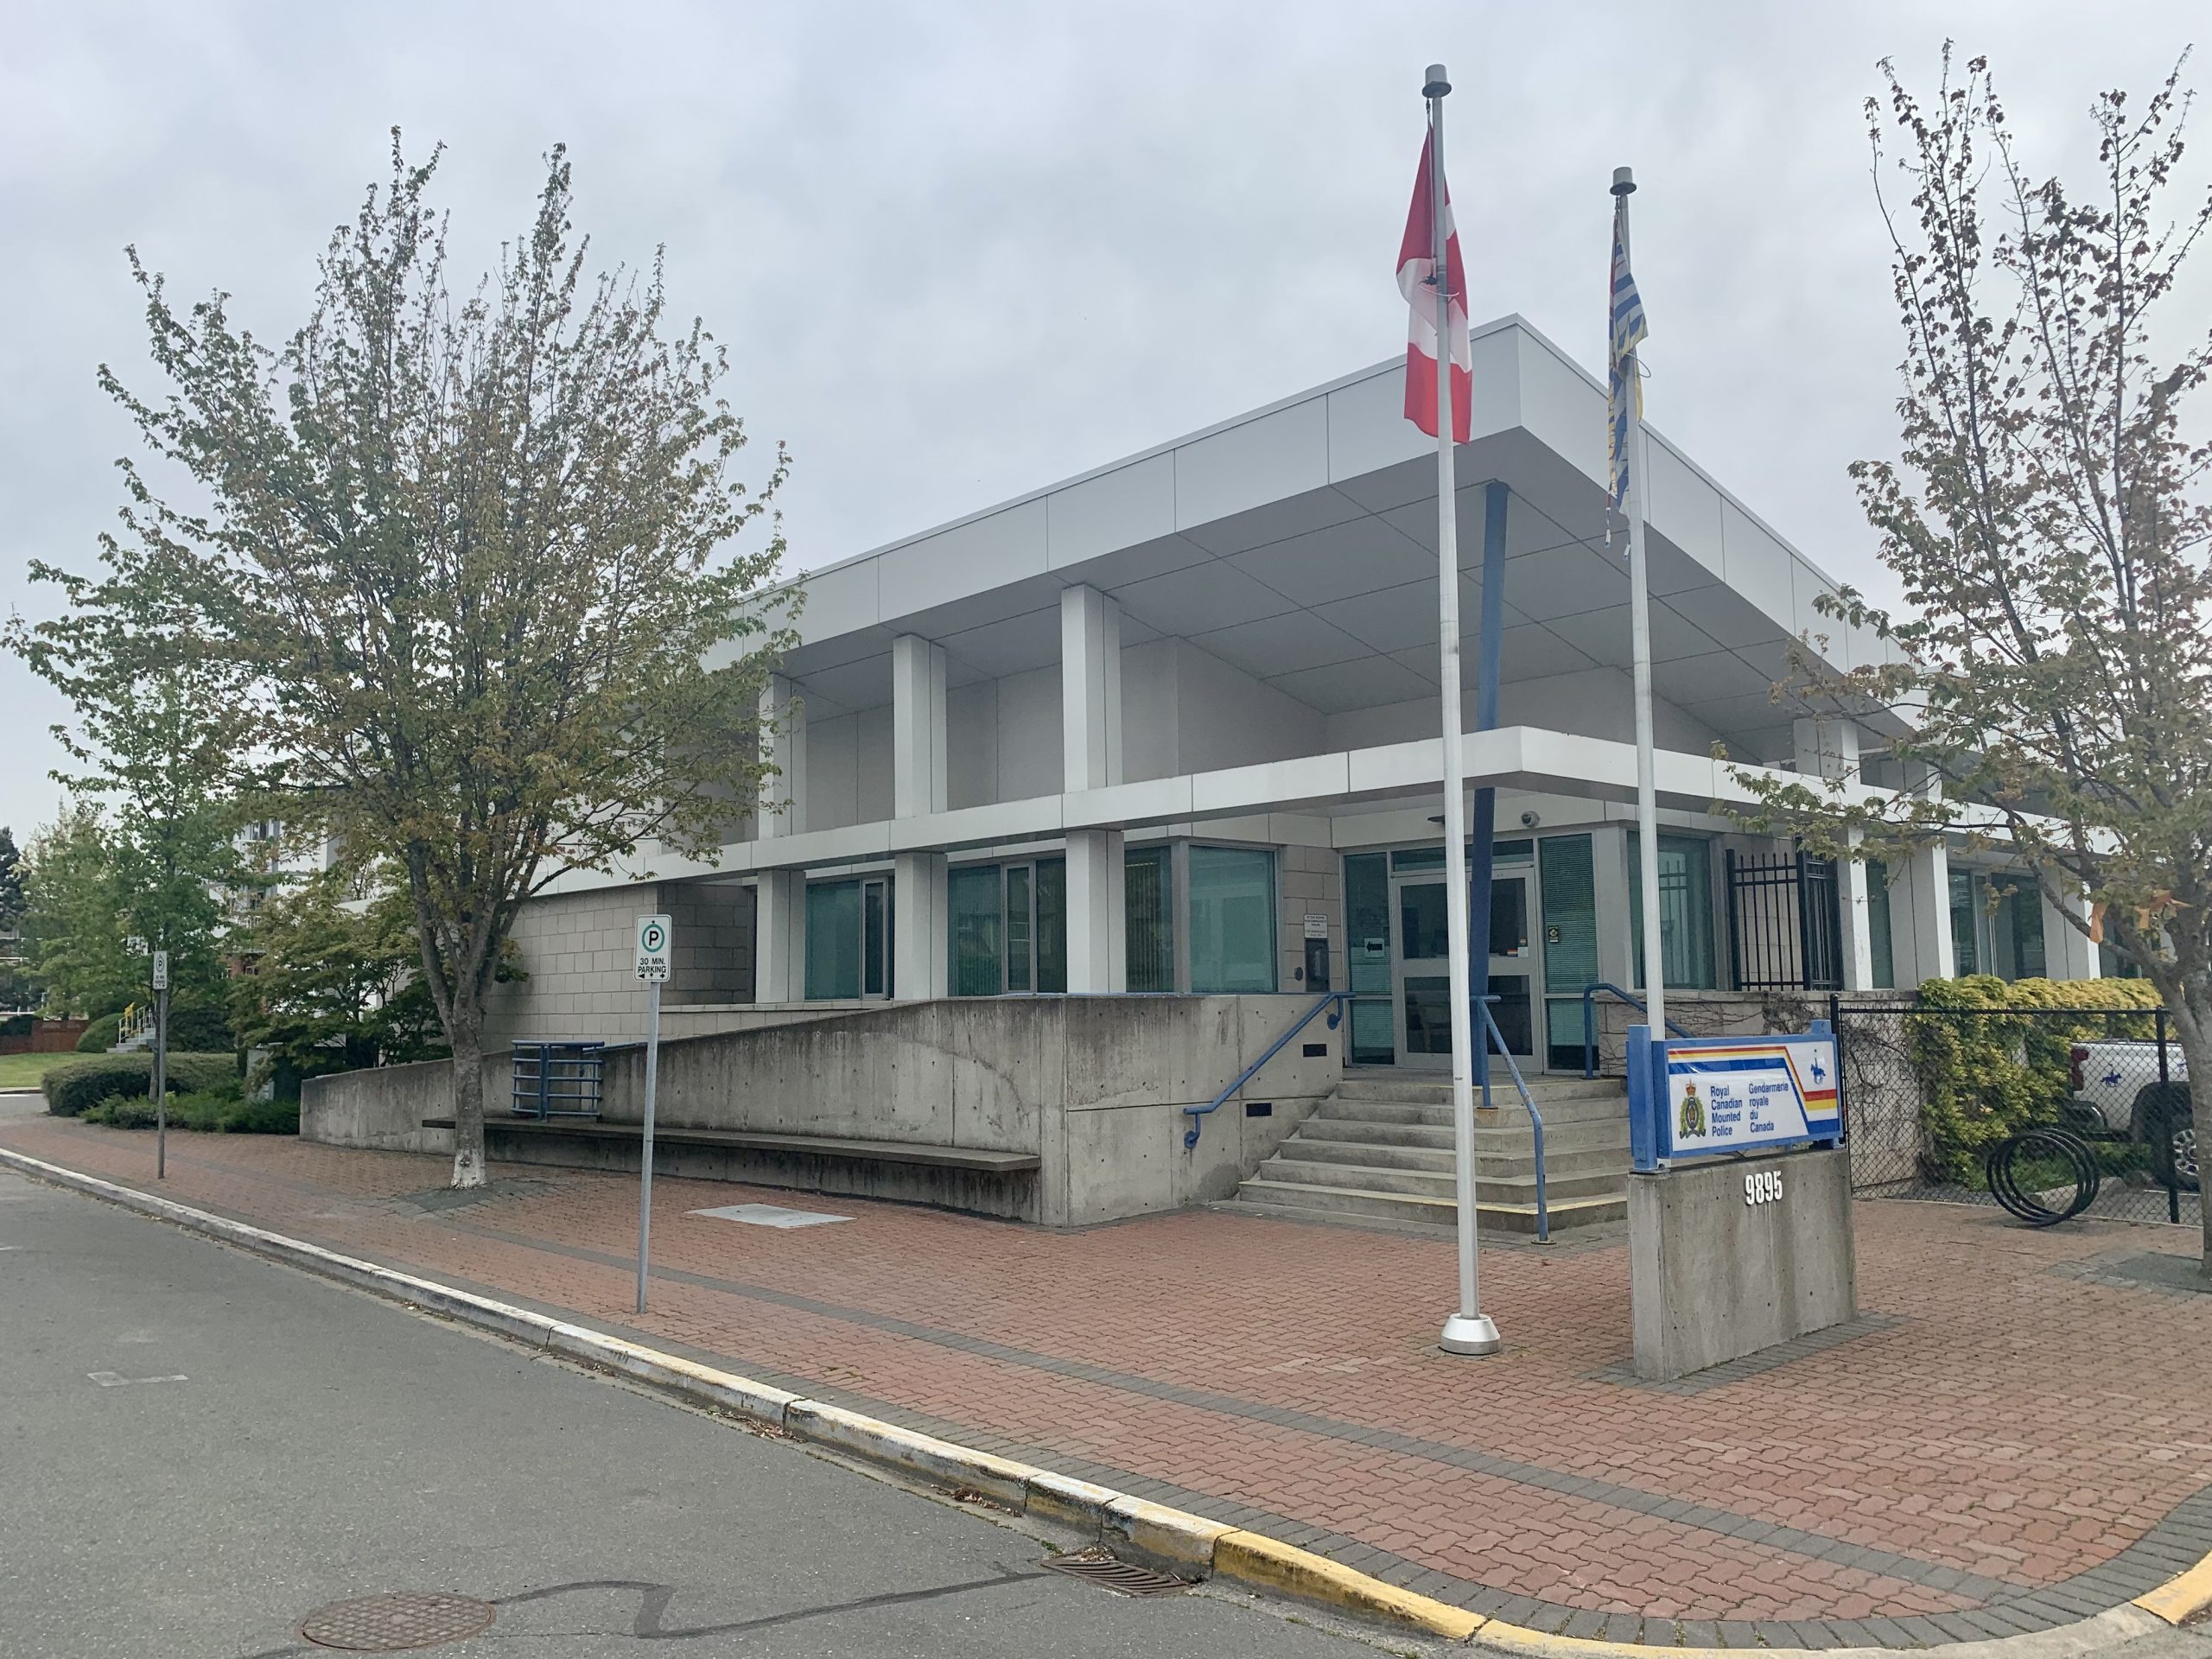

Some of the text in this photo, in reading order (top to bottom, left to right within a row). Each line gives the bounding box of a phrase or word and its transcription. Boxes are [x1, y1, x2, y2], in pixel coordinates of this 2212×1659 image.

[649, 931, 658, 946] P
[1710, 1084, 1730, 1098] Royal
[1748, 1082, 1789, 1094] Gendarmerie
[1711, 1097, 1743, 1110] Canadian
[1749, 1096, 1769, 1108] royale
[1712, 1111, 1741, 1123] Mounted
[1750, 1109, 1758, 1121] du
[1712, 1126, 1732, 1137] Police
[1750, 1121, 1774, 1134] Canada
[1745, 1170, 1783, 1205] 9895
